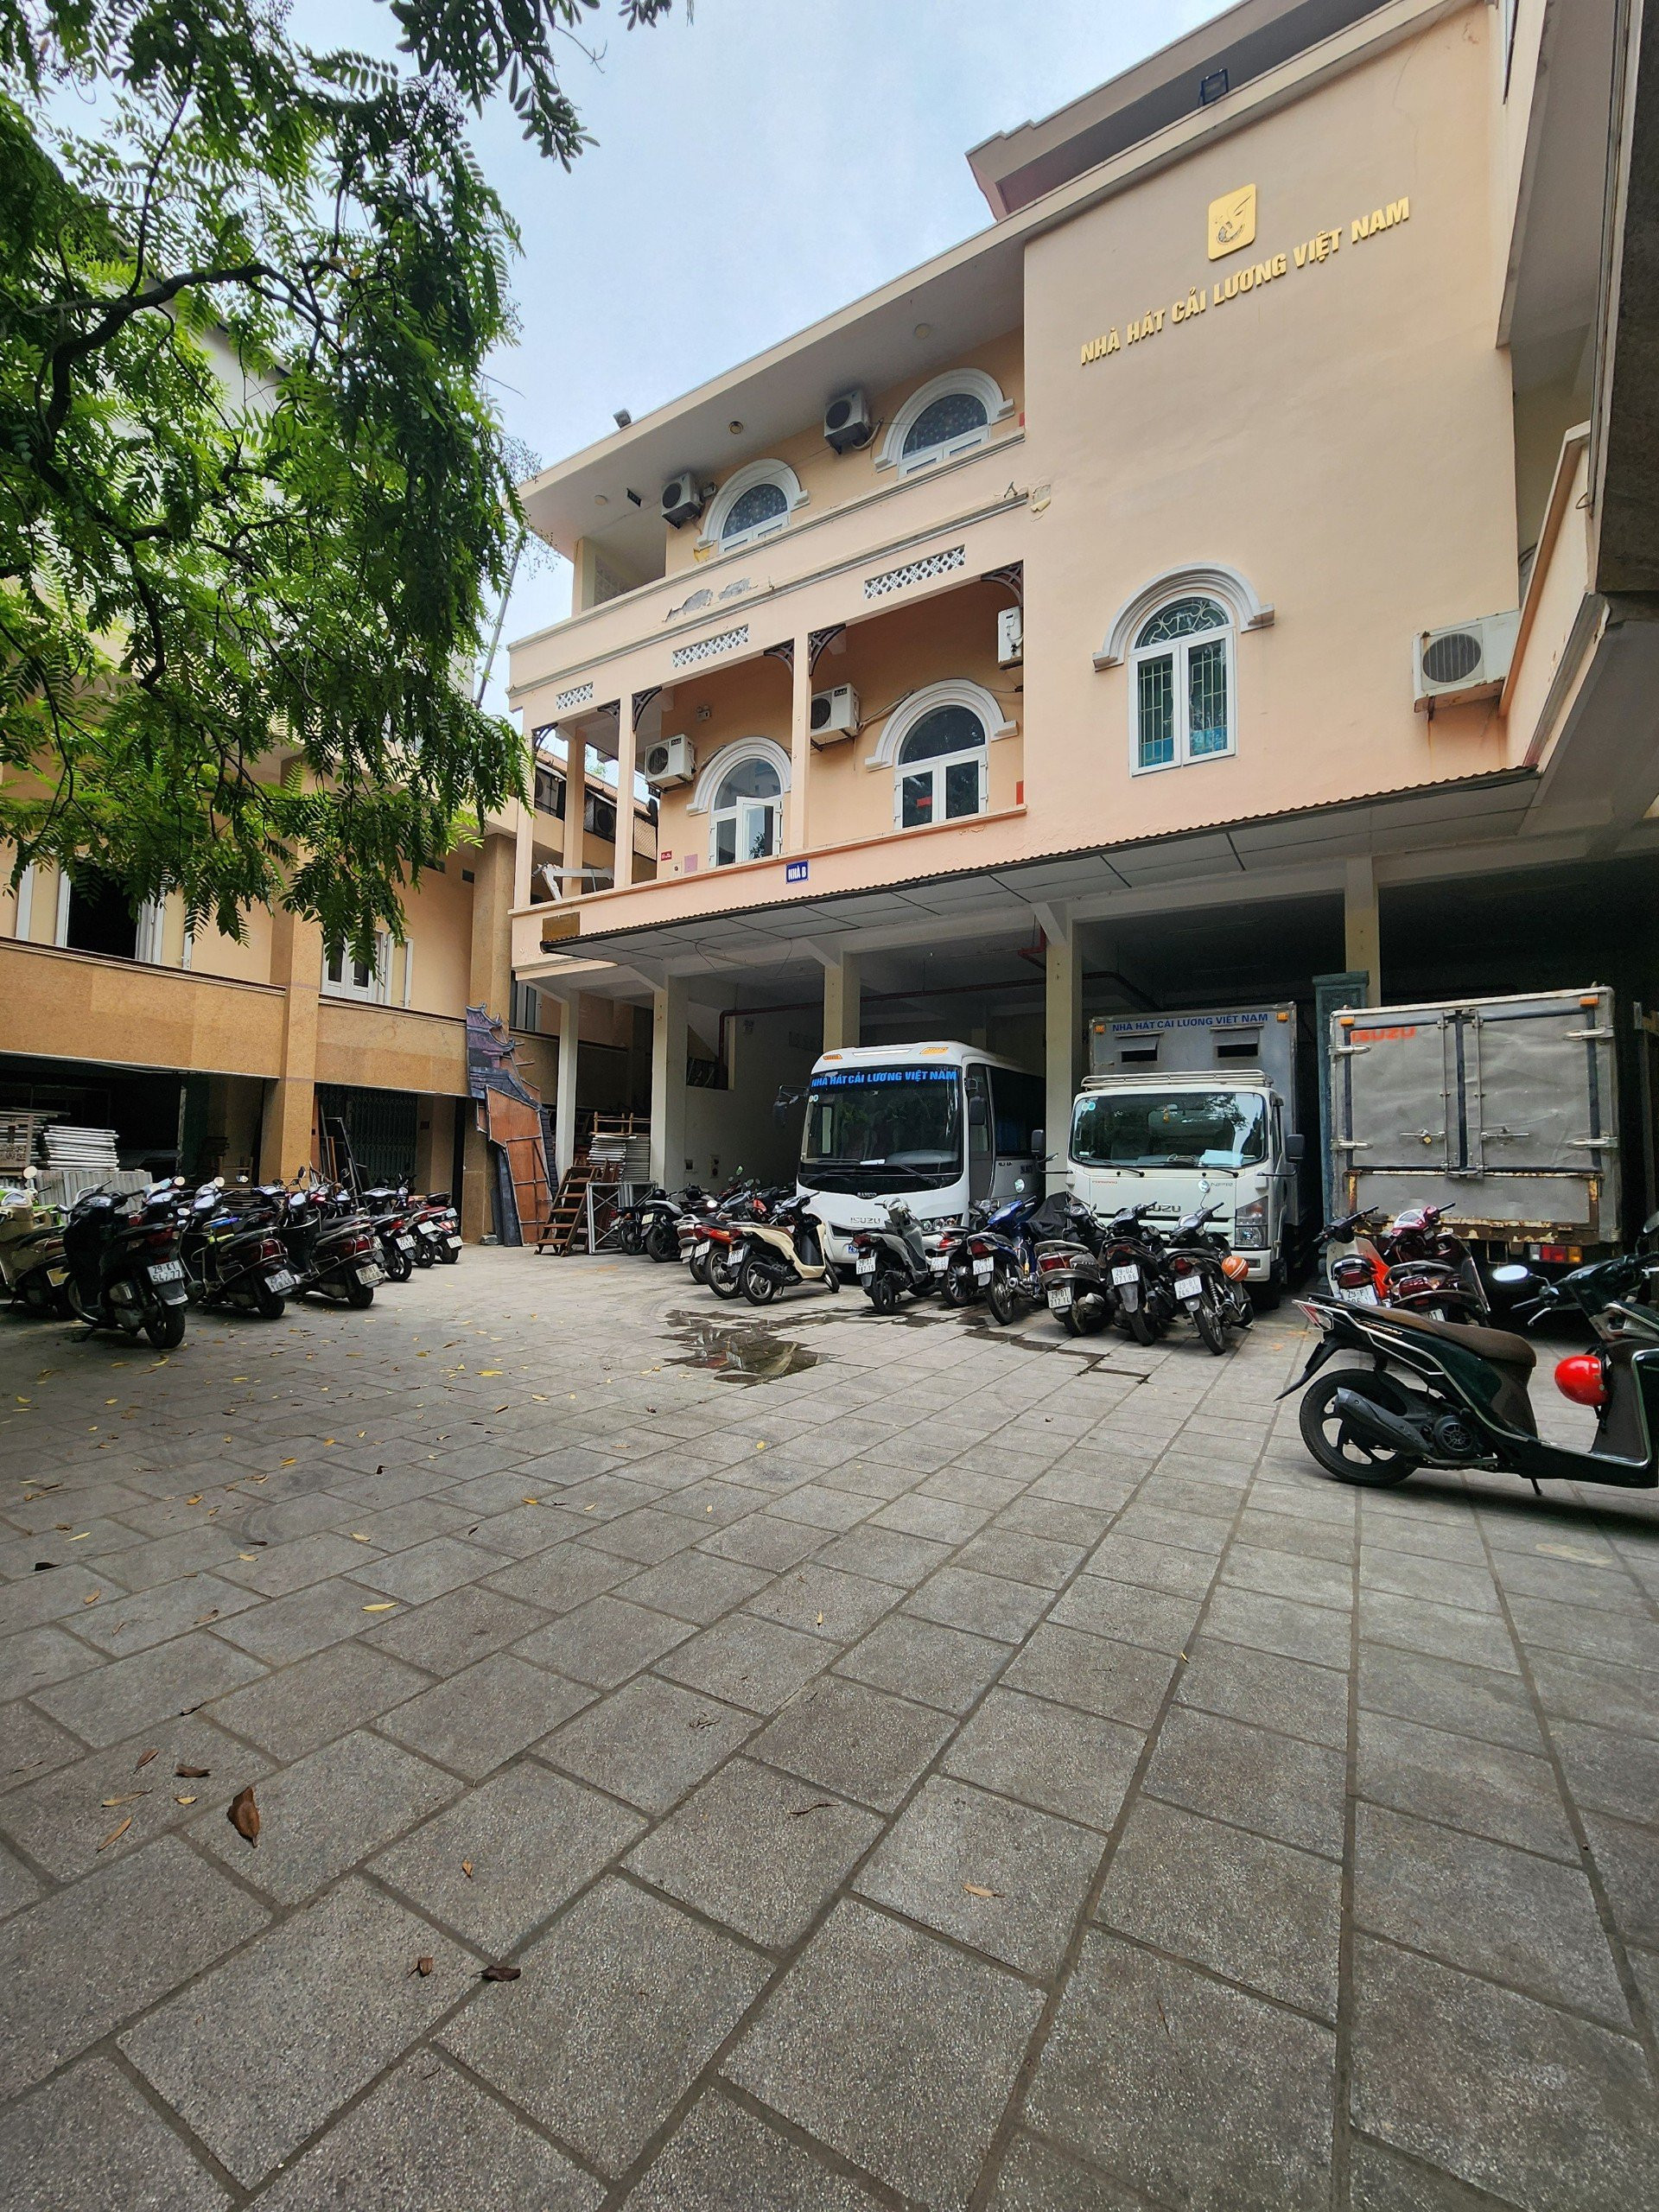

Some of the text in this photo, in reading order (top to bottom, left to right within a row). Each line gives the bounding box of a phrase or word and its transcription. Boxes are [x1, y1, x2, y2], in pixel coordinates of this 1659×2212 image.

[1081, 197, 1410, 365] NHÀ HÁT CẢI LƯƠNG VIỆT NAM
[788, 865, 806, 880] NHÀ B
[1242, 1014, 1268, 1022] NAM
[830, 1074, 848, 1085] HÁT
[848, 1071, 865, 1084] CẢI
[867, 1071, 903, 1083] LƯƠNG
[905, 1070, 928, 1082] VIỆT
[929, 1071, 957, 1080] NAM
[152, 1262, 176, 1274] 29-K1
